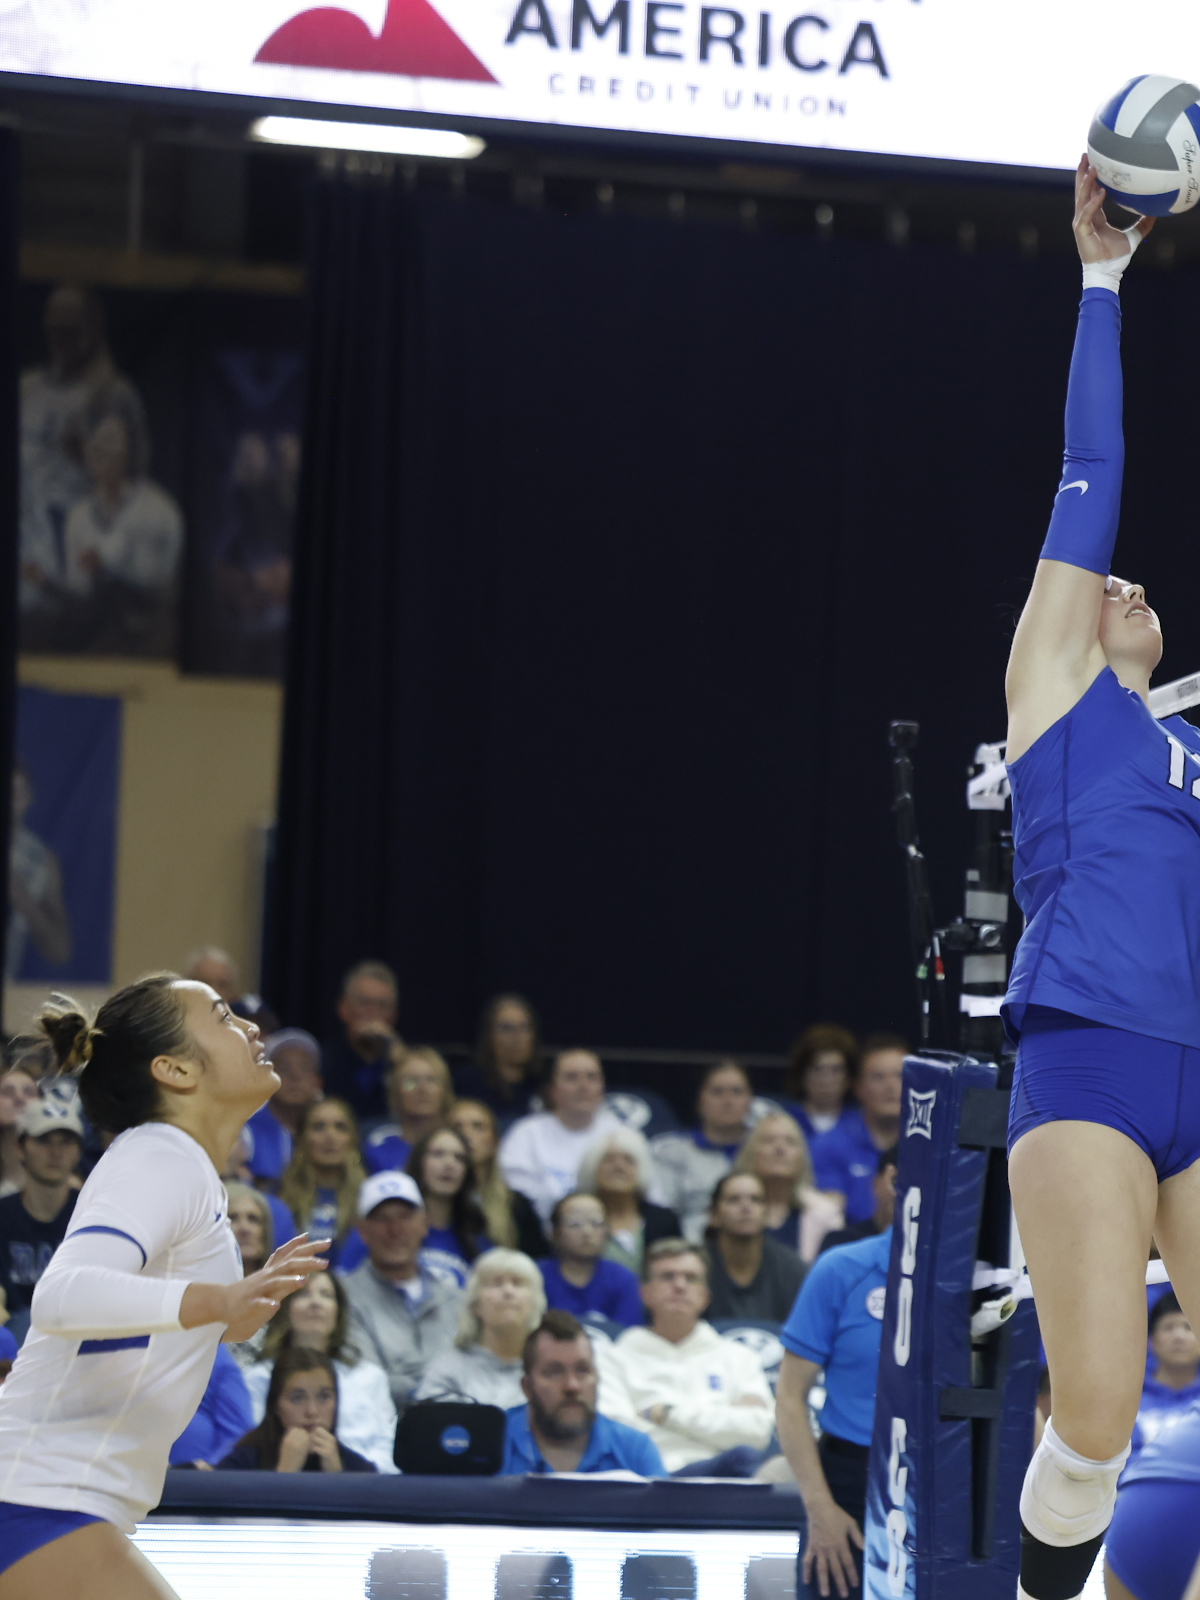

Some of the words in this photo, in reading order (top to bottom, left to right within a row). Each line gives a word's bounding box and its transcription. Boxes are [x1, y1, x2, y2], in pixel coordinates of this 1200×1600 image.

[505, 0, 891, 80] AMERICA
[548, 73, 700, 105] CREDIT
[723, 89, 847, 118] UNION
